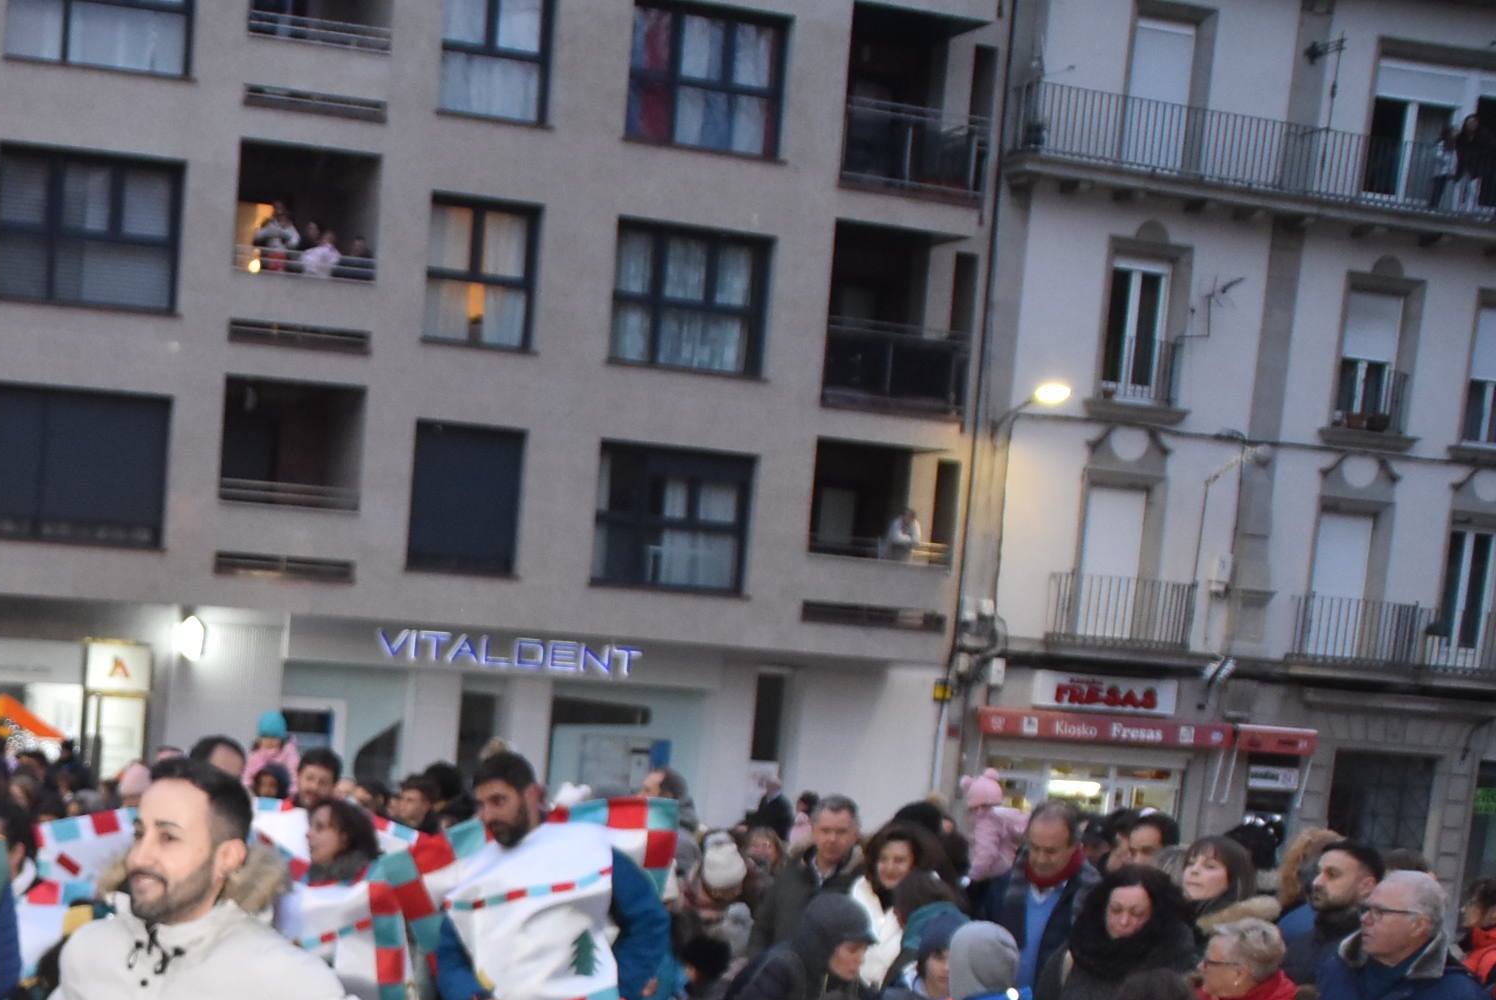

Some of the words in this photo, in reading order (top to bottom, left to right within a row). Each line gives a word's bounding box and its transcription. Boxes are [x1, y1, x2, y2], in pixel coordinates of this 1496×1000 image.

[377, 627, 642, 676] VITALDENT
[1054, 683, 1158, 710] FRESAS
[1054, 718, 1099, 739] Kiosko
[1110, 721, 1164, 743] Fresas
